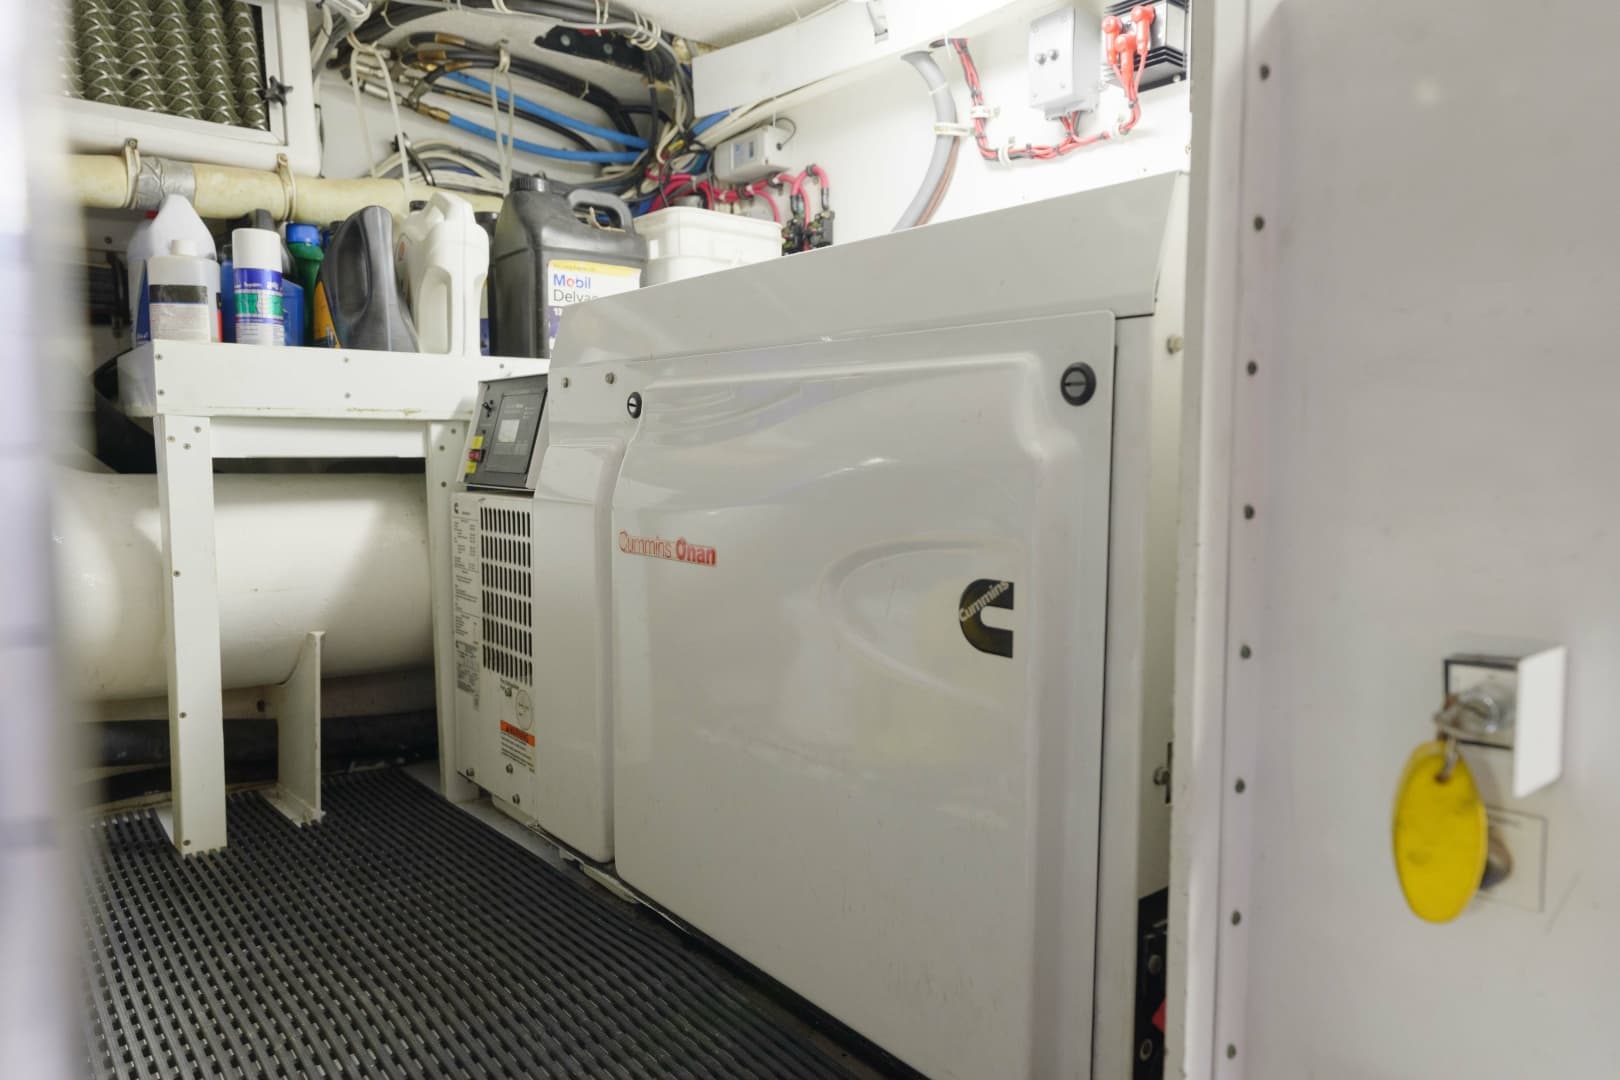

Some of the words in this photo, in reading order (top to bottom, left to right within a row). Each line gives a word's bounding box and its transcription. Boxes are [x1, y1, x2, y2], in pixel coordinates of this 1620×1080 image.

[553, 273, 591, 289] Mobil
[618, 530, 672, 559] Cummins
[675, 538, 717, 566] Onan
[959, 581, 1009, 622] Cummins
